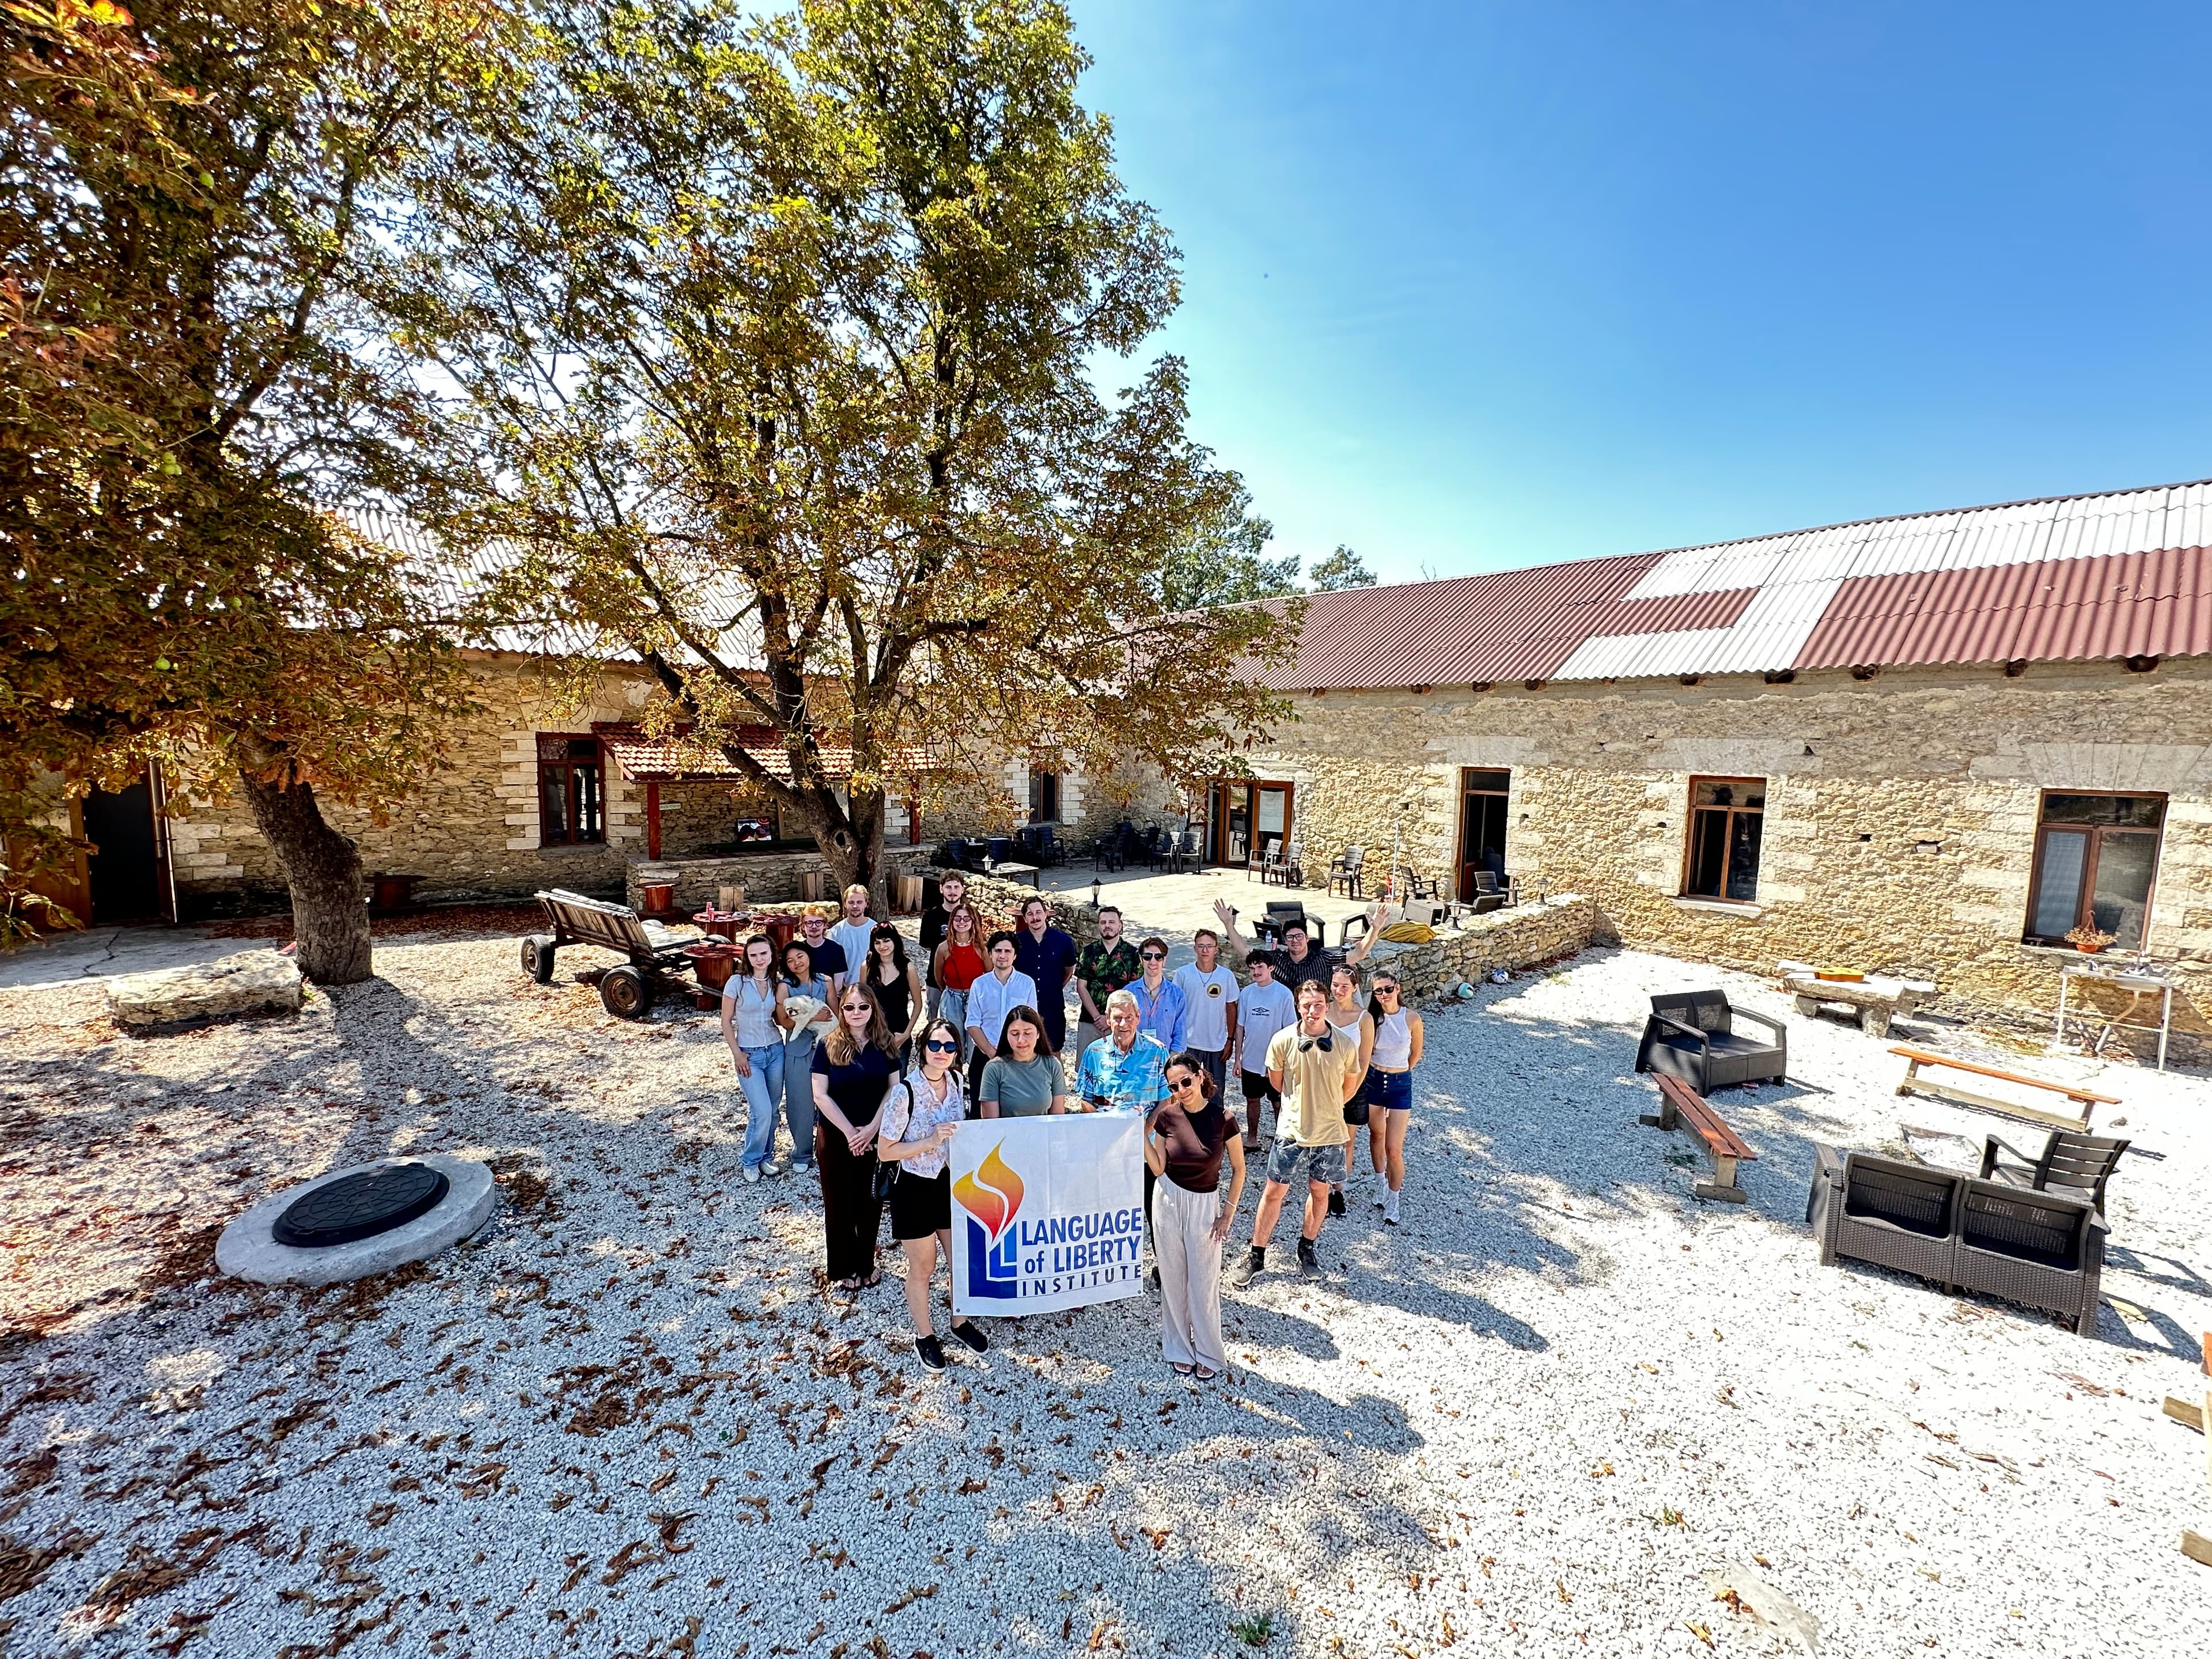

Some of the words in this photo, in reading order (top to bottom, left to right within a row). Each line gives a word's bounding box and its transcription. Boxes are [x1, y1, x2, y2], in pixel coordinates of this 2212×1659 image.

[1021, 1207, 1142, 1246] LANGUAGE
[1025, 1250, 1044, 1274] of
[1054, 1236, 1141, 1273] LIBERTY
[1022, 1264, 1141, 1296] INSTITUTE
